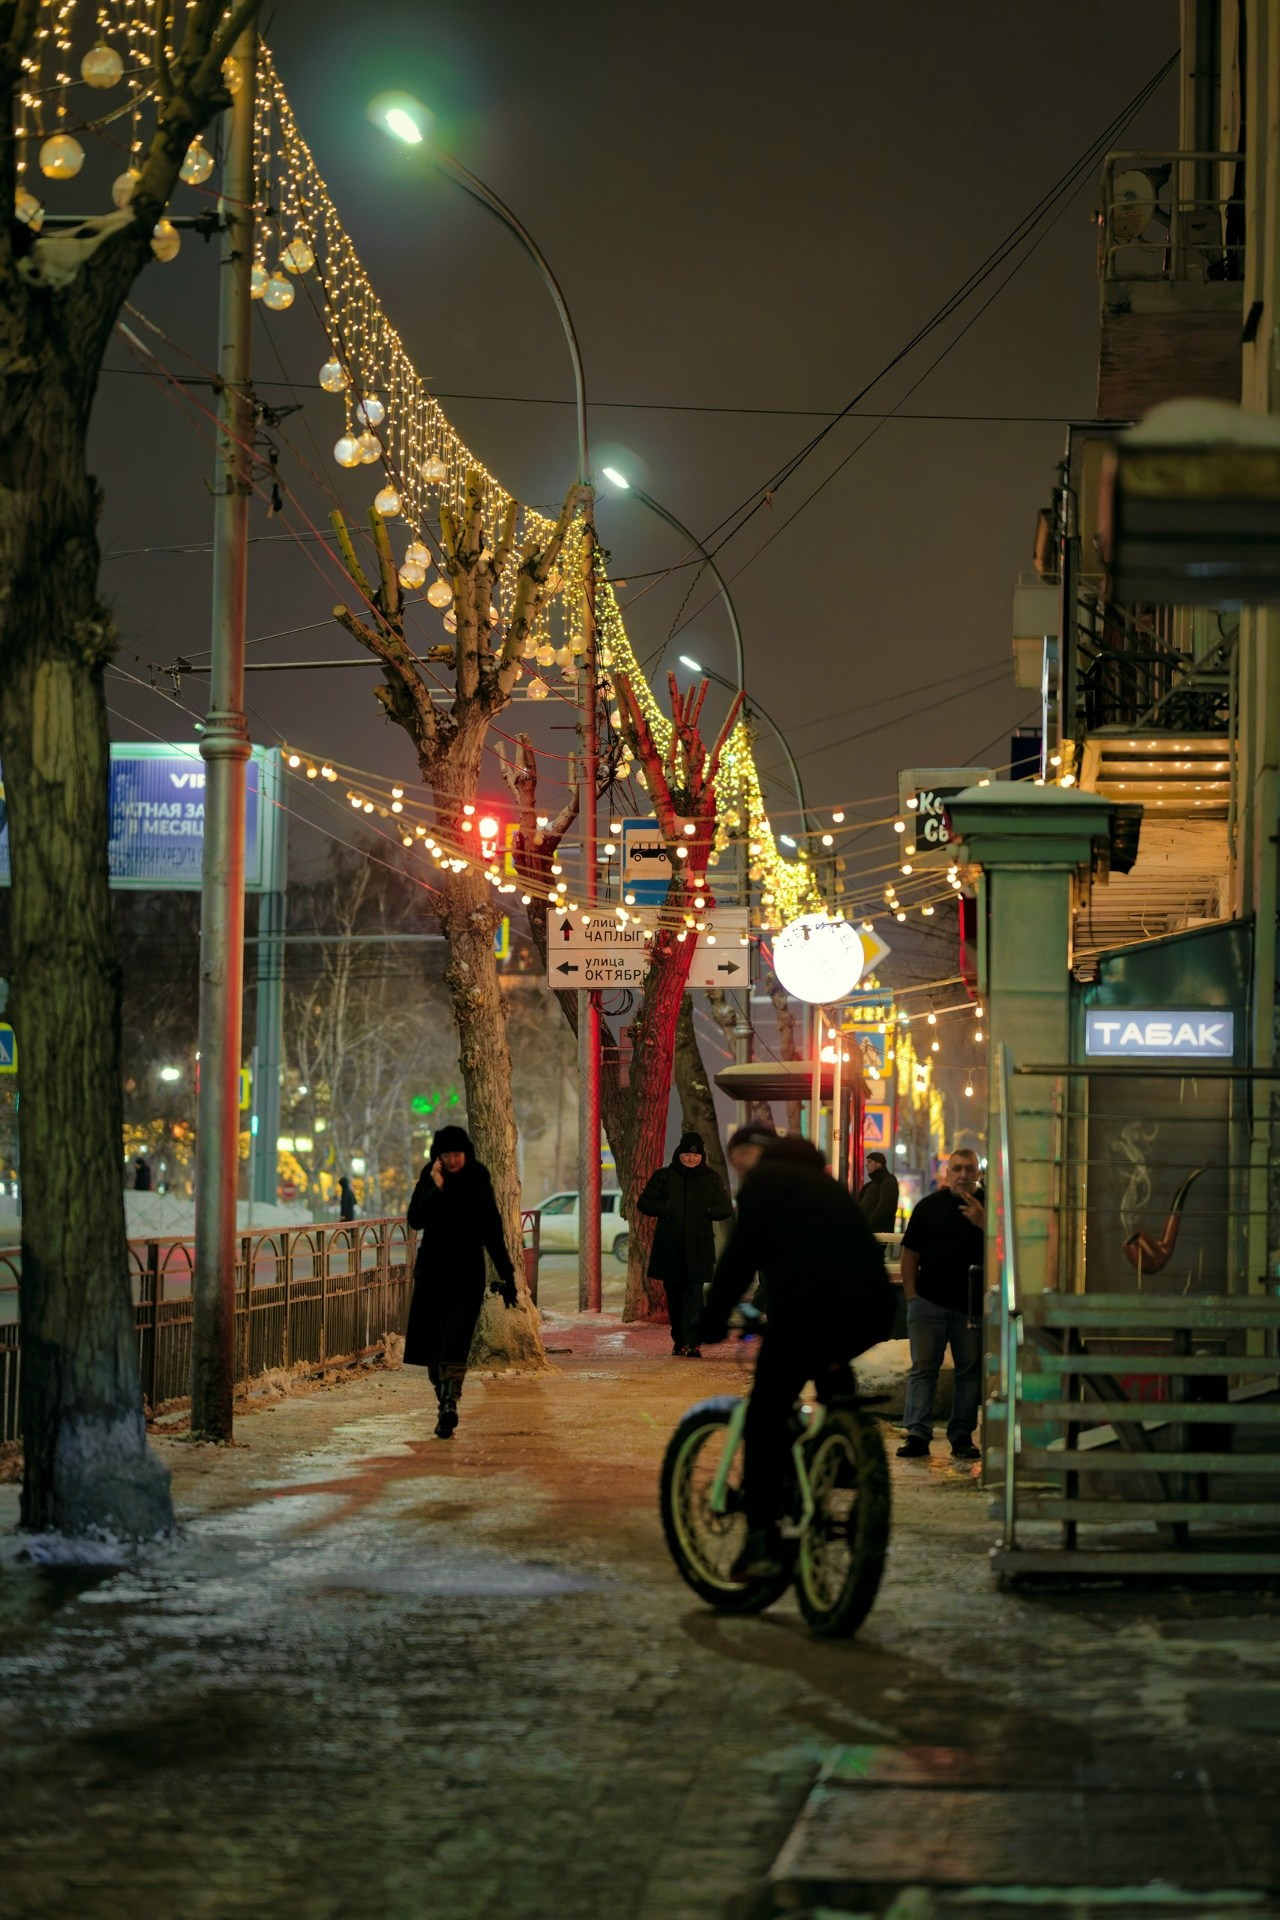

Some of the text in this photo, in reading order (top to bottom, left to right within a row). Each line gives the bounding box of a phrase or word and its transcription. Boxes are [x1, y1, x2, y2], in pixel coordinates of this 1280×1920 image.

[143, 820, 205, 839] МЕСЯЦ
[585, 957, 625, 968] улица
[1094, 1022, 1224, 1046] ТАБАК
